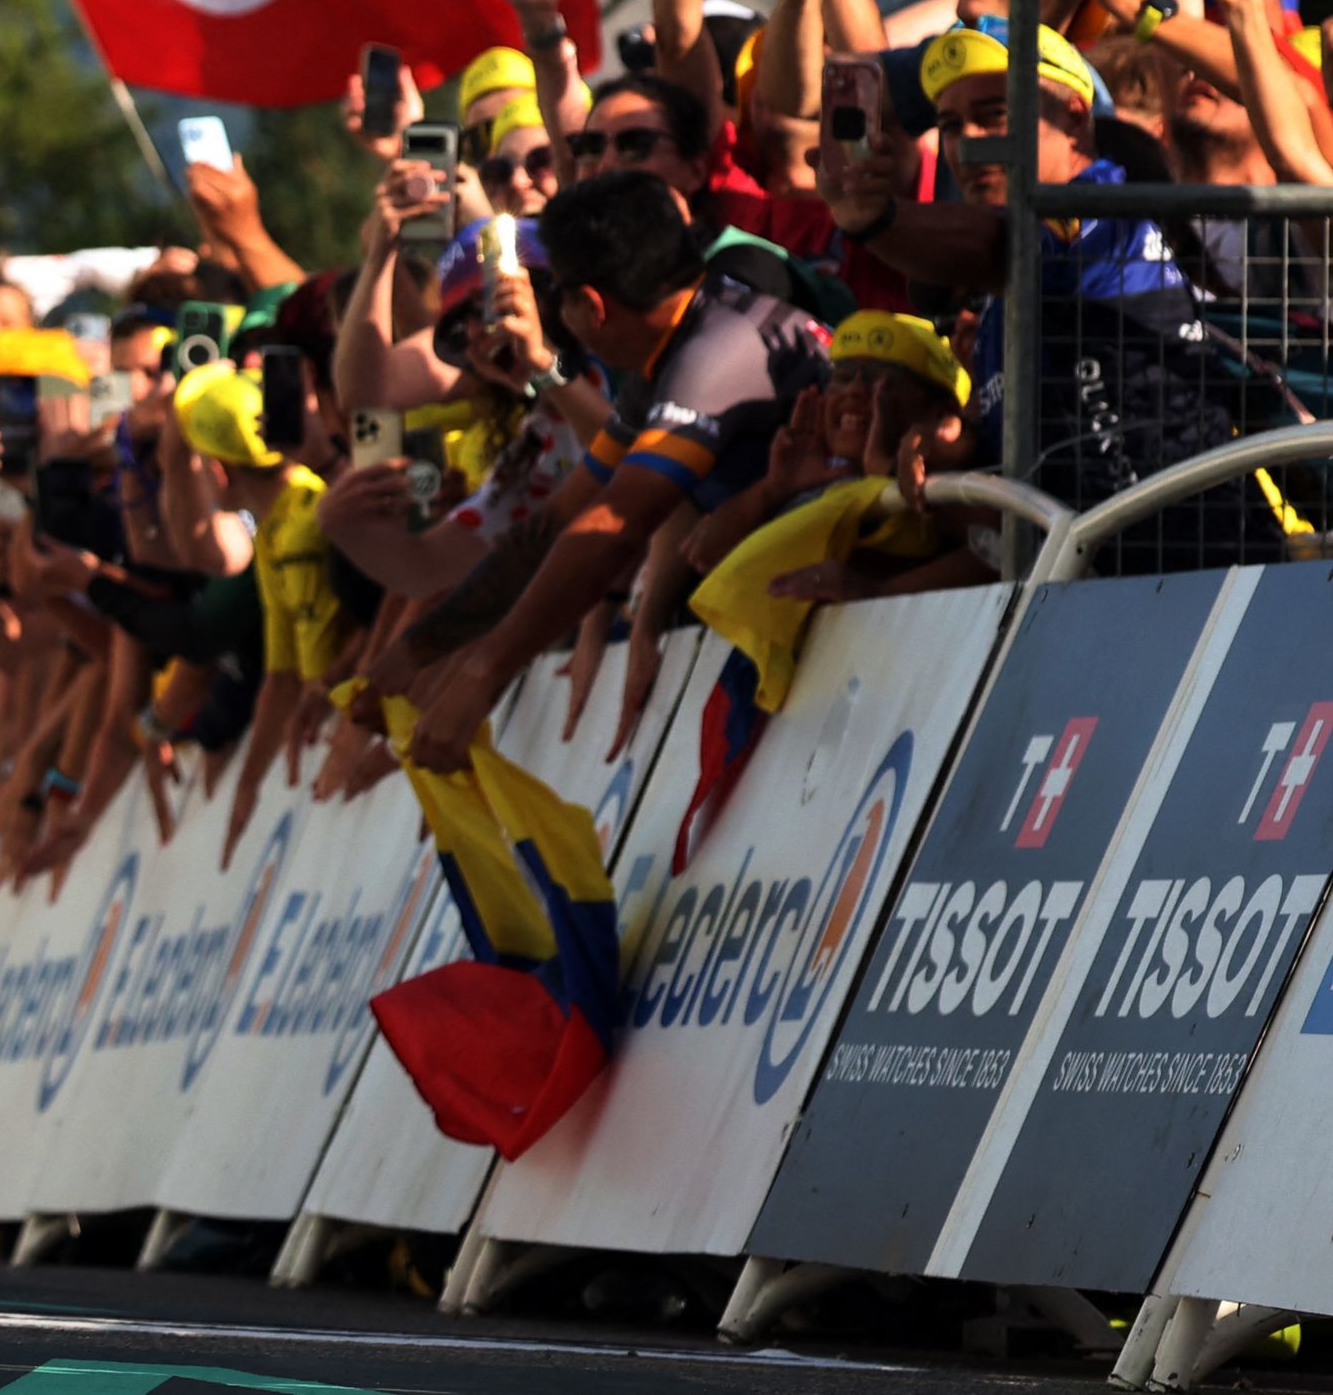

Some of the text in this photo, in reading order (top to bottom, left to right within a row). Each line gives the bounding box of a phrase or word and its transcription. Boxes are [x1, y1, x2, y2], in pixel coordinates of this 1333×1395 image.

[867, 879, 1084, 1017] TISSOT
[1093, 873, 1329, 1020] TISSOT
[826, 1043, 1011, 1090] SWISS WATCHES SINCE 1853
[1053, 1051, 1248, 1095] SWISS WATCHES SINCE 1853
